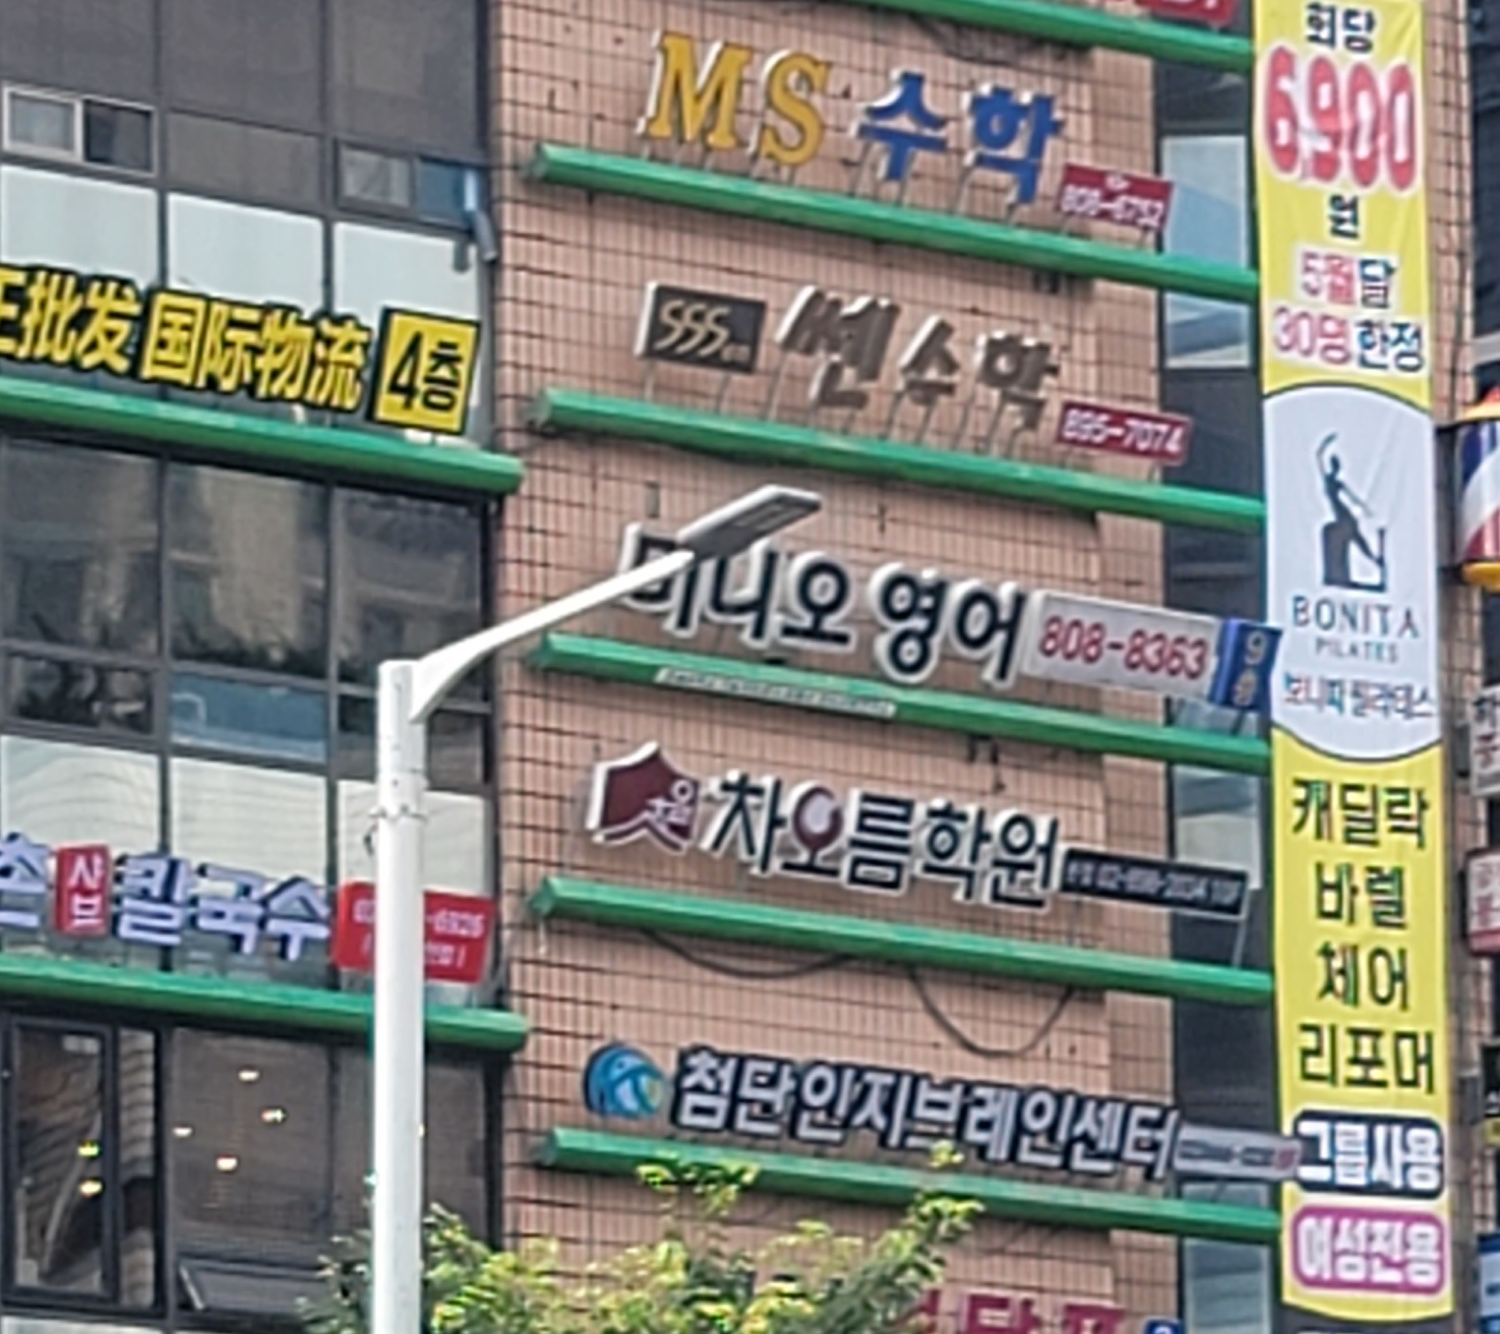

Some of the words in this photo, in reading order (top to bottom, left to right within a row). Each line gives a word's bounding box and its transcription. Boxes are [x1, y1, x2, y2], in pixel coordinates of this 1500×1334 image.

[646, 31, 830, 167] MS
[853, 71, 1065, 205] 수학
[1328, 194, 1360, 240] 원
[388, 331, 468, 412] 4층
[876, 565, 1026, 682] 영어
[1292, 595, 1419, 639] BONITA
[707, 772, 1060, 907] 차오름학원
[1292, 778, 1428, 849] 캐딜락
[115, 853, 332, 961] 칼국수
[1299, 1023, 1435, 1095] 리포머
